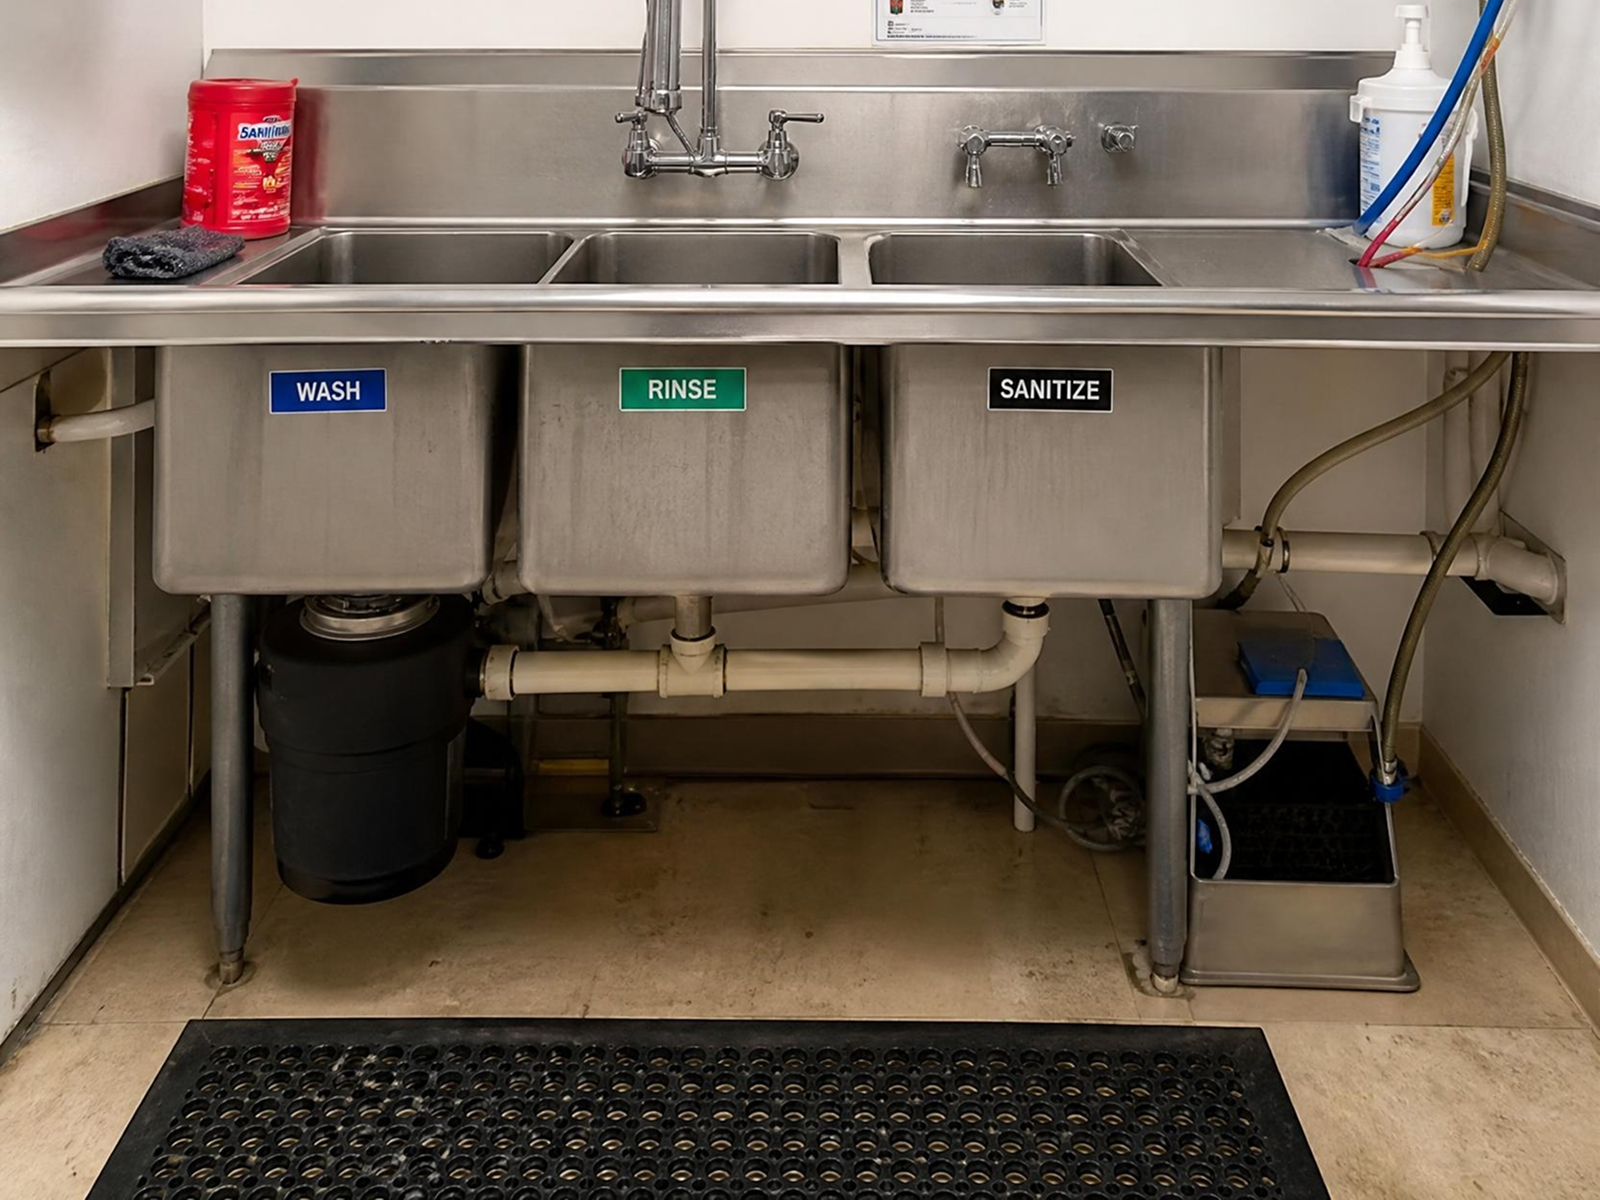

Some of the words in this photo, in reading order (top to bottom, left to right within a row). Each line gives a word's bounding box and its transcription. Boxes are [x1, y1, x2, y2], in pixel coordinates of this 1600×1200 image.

[296, 380, 361, 402] WASH
[648, 378, 717, 400] RINSE
[1000, 378, 1100, 401] SANITIZE
